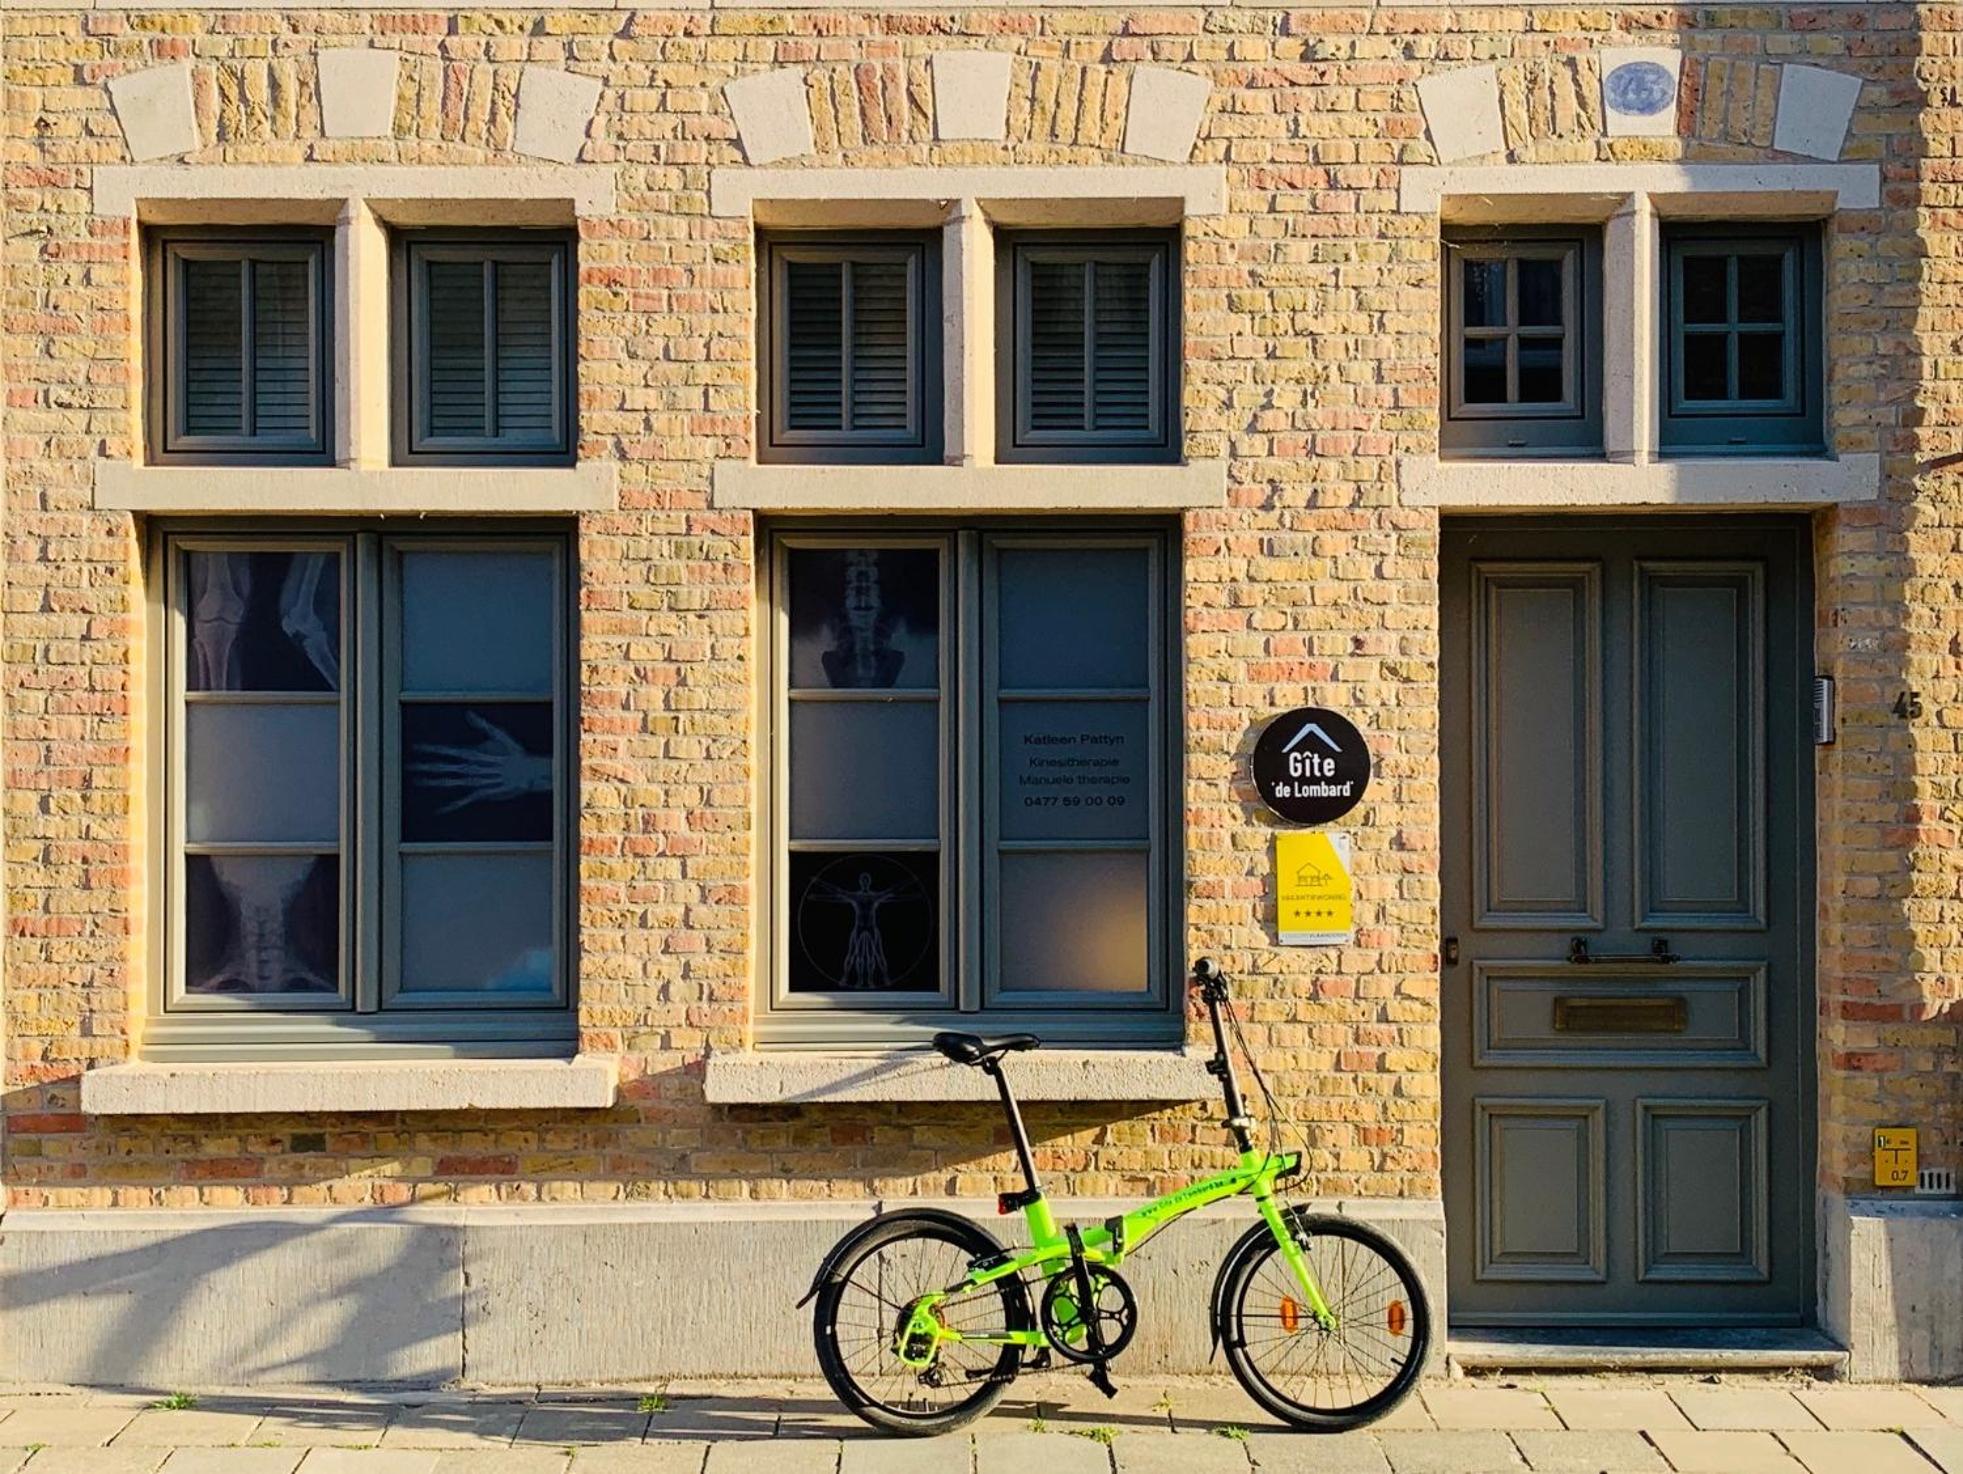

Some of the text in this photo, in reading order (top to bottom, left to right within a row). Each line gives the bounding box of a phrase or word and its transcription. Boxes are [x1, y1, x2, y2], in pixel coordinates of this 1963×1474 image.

[1892, 691, 1923, 719] 45
[1080, 734, 1125, 746] Pattyn
[1288, 751, 1336, 778] Gîte
[1024, 796, 1059, 807] 0477
[1062, 796, 1081, 806] 59
[1085, 796, 1104, 806] 00
